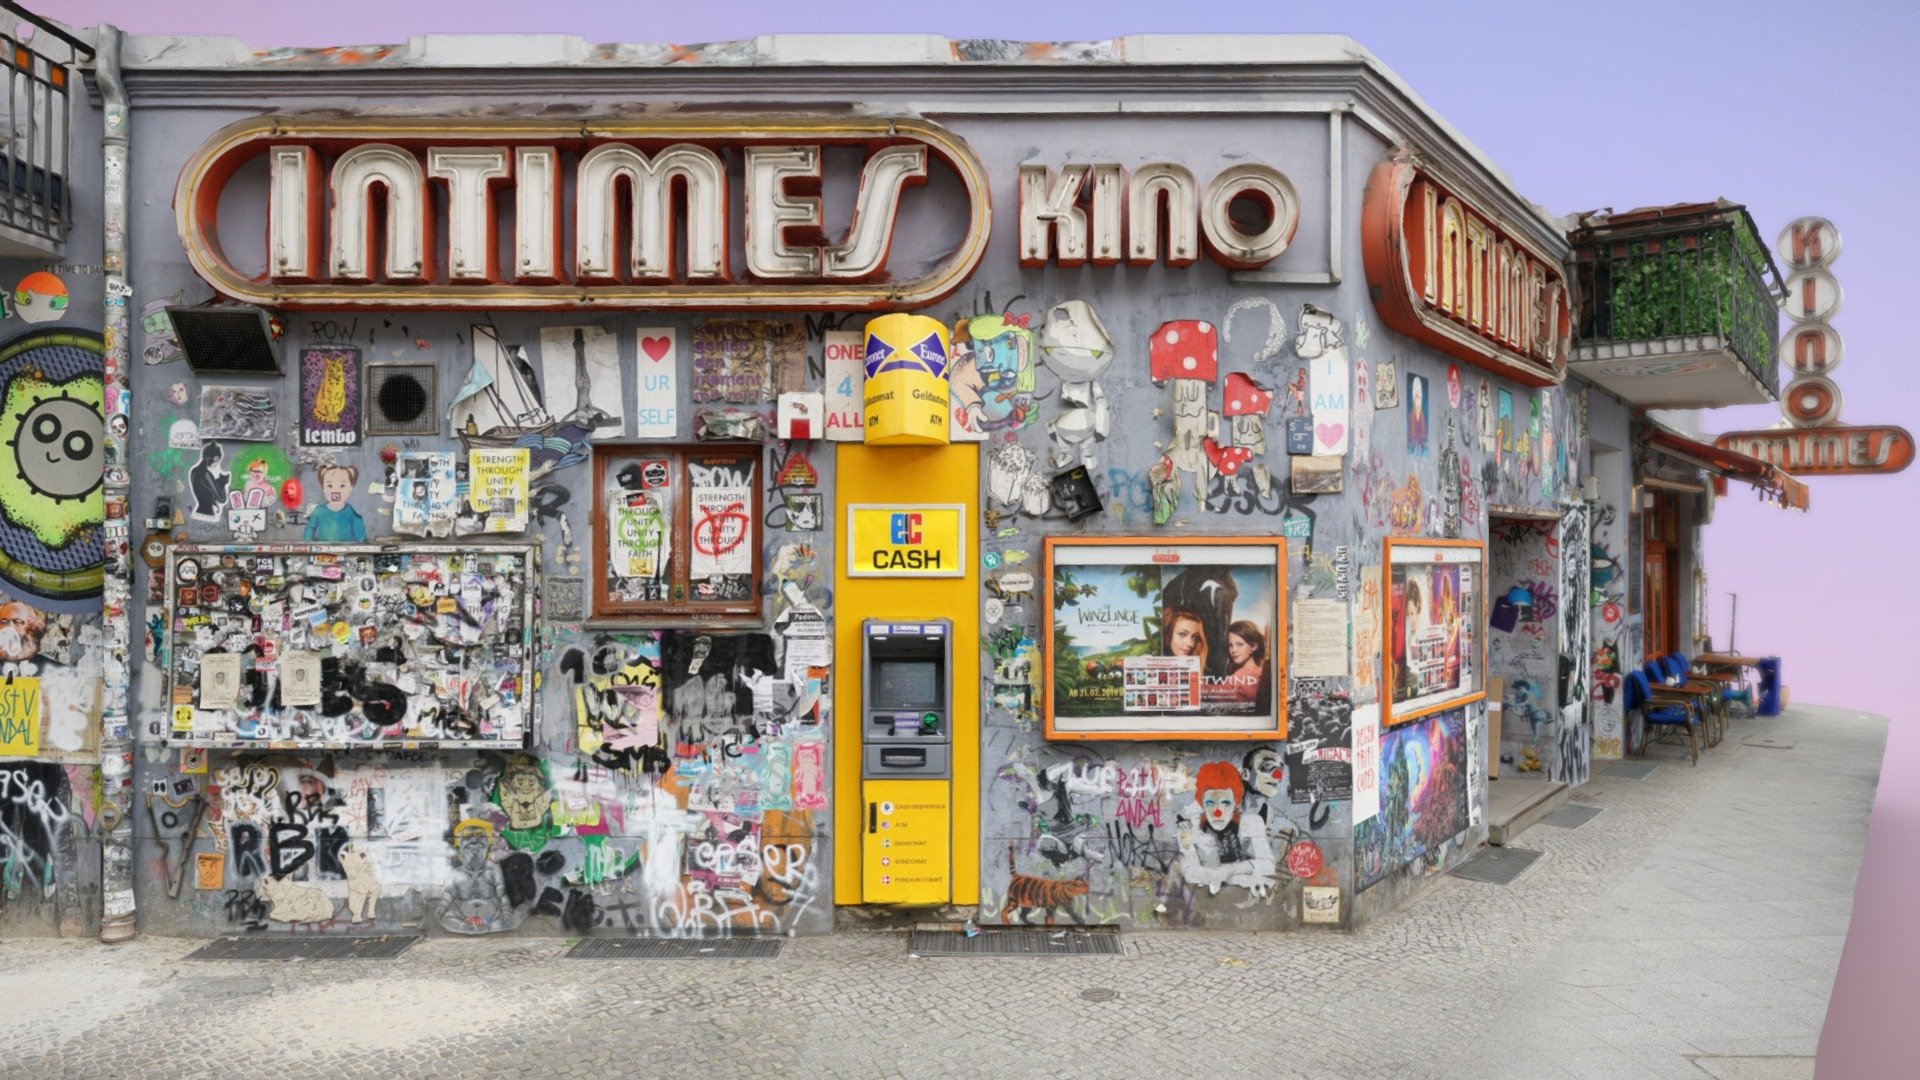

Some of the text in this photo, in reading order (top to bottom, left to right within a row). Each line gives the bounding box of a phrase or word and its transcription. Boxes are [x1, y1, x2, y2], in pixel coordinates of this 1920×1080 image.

[826, 343, 864, 361] ONE
[1327, 362, 1331, 375] I
[644, 375, 670, 392] UR
[837, 374, 853, 397] 4
[1315, 393, 1345, 410] AM
[639, 409, 674, 425] SELF
[827, 412, 865, 429] ALL
[868, 413, 880, 427] ATM
[929, 413, 943, 427] ATM
[305, 429, 357, 444] lembo
[475, 455, 524, 464] STRENGTH
[477, 466, 523, 475] THROUGH
[486, 477, 514, 486] UNITY
[486, 487, 514, 496] UNITY
[698, 493, 746, 502] STRENGTH
[618, 507, 661, 516] THROUGH
[698, 504, 745, 513] THROUGH
[627, 518, 654, 527] UNITY
[627, 529, 654, 538] UNITY
[708, 526, 736, 535] UNITY
[618, 540, 662, 549] THROUGH
[699, 536, 745, 545] THROUGH
[628, 549, 653, 558] FAITH
[872, 549, 941, 570] CASH
[513, 831, 545, 850] TAG
